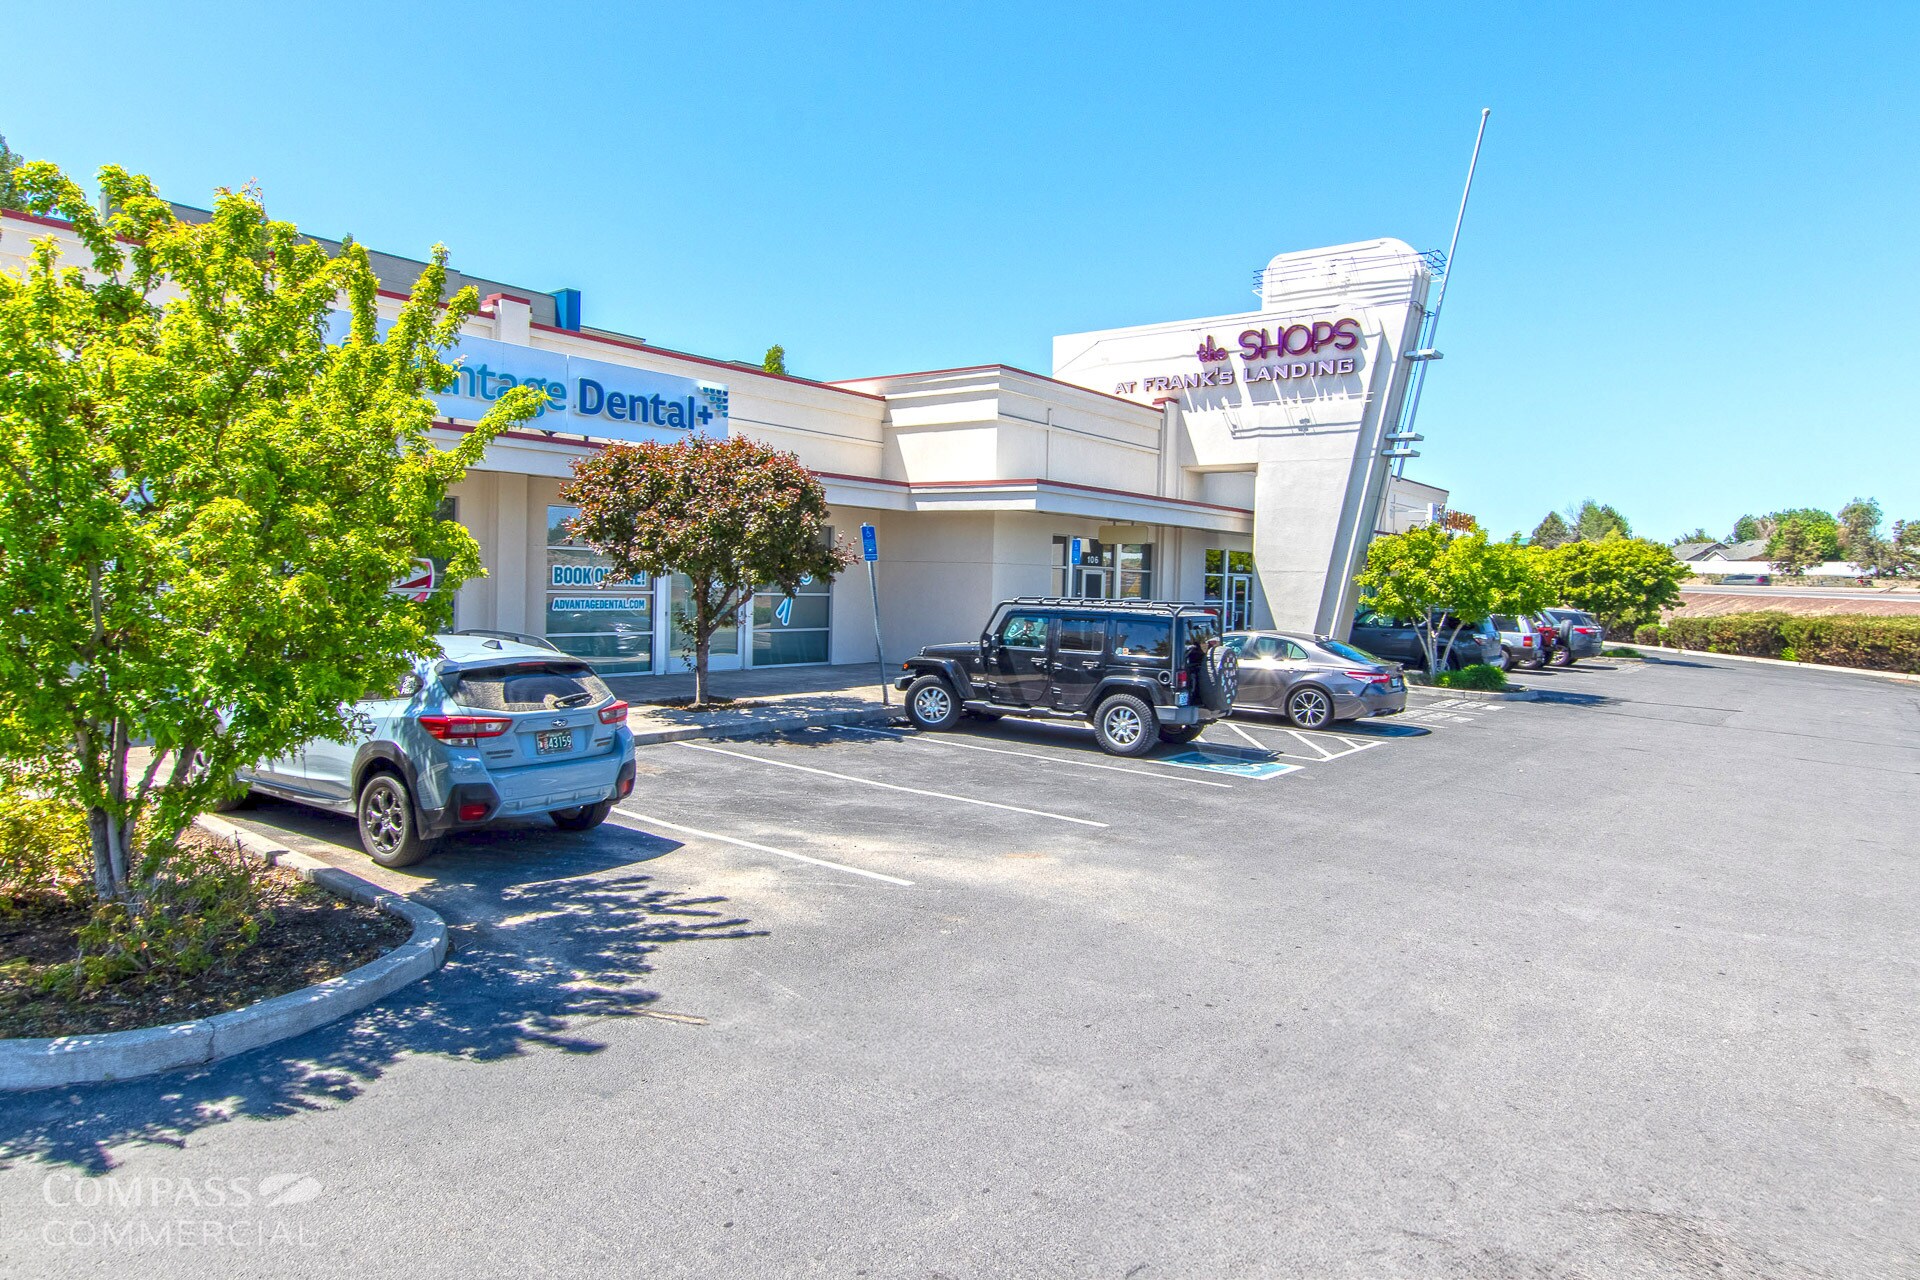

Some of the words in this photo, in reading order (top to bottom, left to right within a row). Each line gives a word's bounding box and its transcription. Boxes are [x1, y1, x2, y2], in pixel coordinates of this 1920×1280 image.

[1196, 335, 1228, 362] the
[1238, 318, 1360, 360] SHOPS
[1115, 381, 1136, 395] AT
[1143, 367, 1234, 392] FRANK'S
[1243, 358, 1355, 384] LANDING
[578, 377, 713, 430] Dental+
[1087, 556, 1099, 564] 106
[553, 566, 592, 584] BOOK
[553, 599, 645, 610] ADVANTAGEDENTAL.COM
